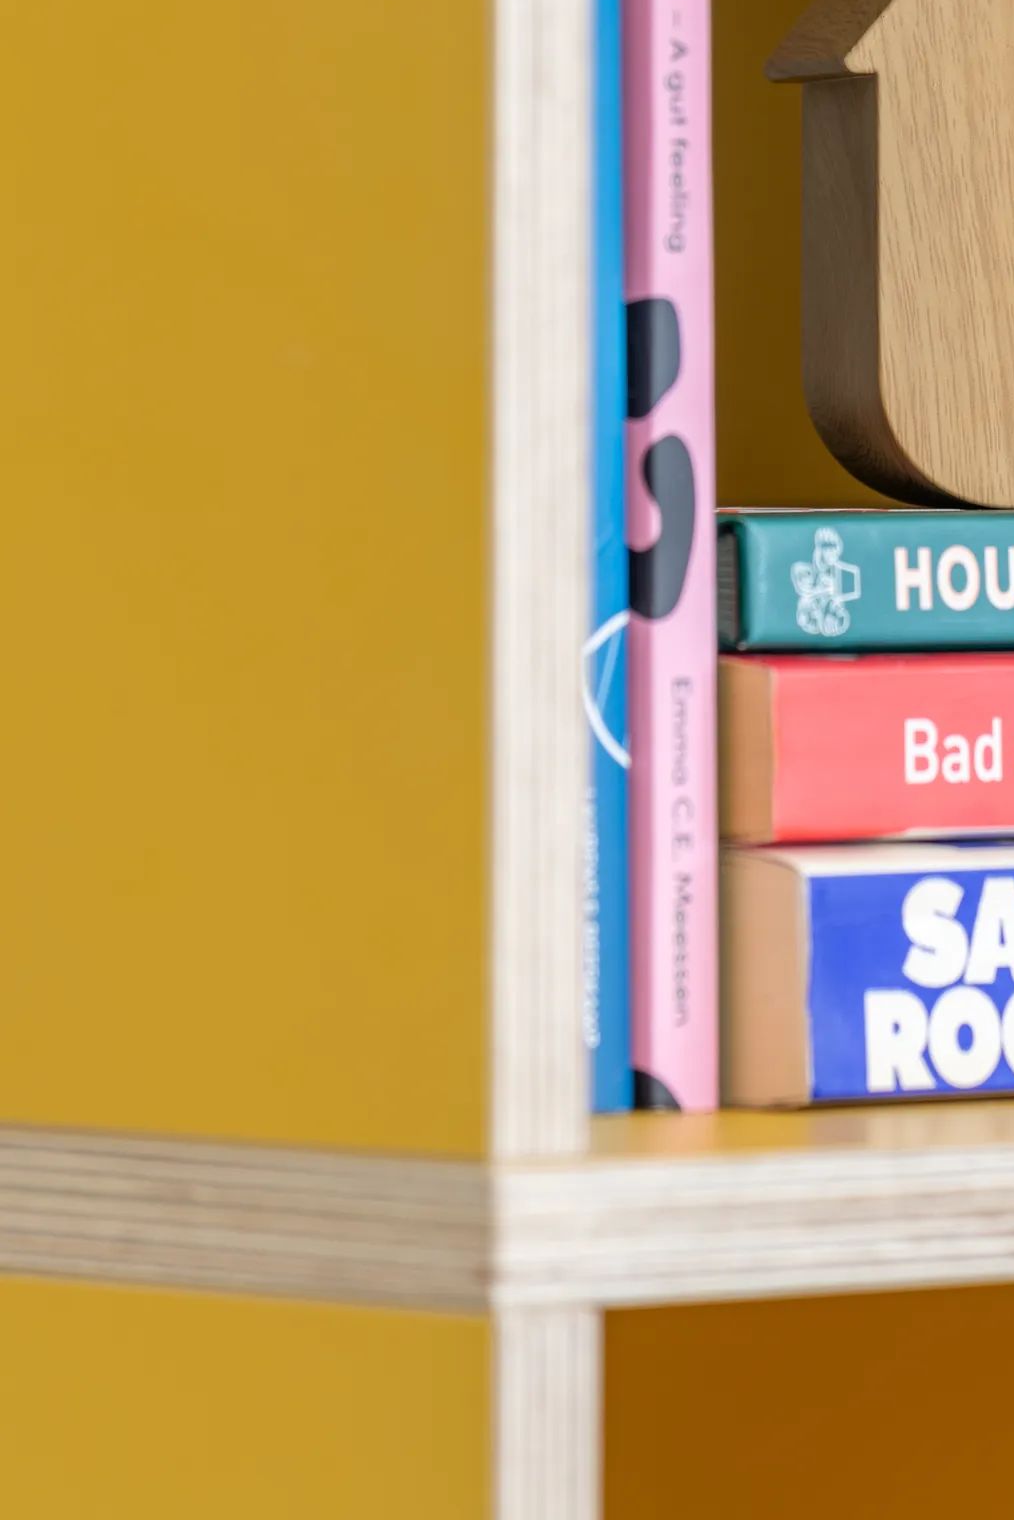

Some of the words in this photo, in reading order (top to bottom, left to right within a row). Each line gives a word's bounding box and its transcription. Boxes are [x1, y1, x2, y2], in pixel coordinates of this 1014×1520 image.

[669, 38, 688, 62] A
[664, 71, 687, 126] gut
[664, 137, 689, 255] feeling
[670, 677, 692, 786] Emma
[903, 716, 1004, 785] Bad
